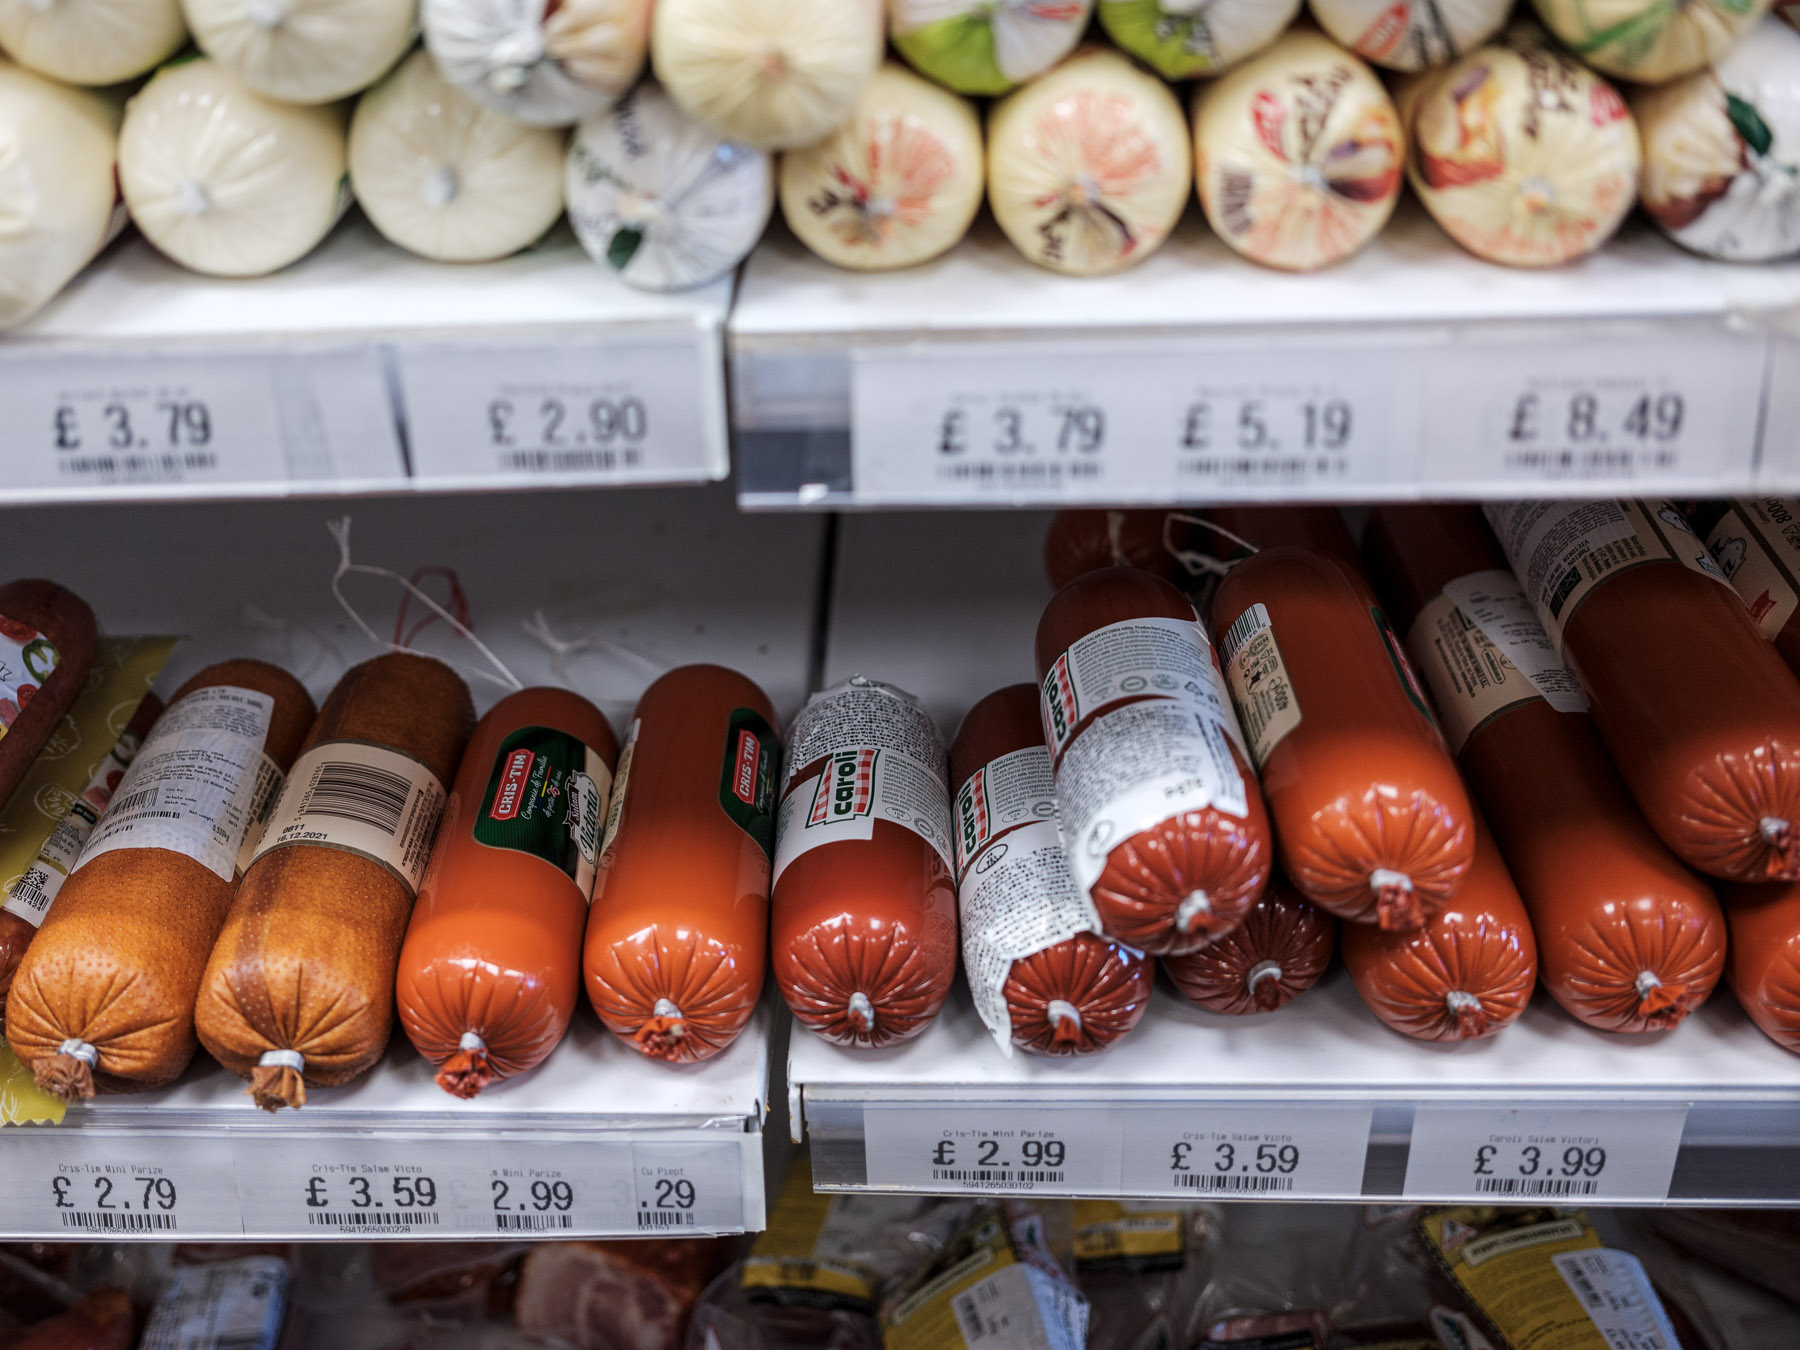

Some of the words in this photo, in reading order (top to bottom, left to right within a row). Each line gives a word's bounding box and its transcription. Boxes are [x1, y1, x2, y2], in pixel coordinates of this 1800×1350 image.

[54, 404, 82, 450] £
[104, 401, 212, 449] 3.79
[488, 400, 516, 445] £
[540, 397, 648, 444] 2.90
[939, 408, 966, 454] £
[993, 405, 1105, 453] 3.79
[1180, 401, 1210, 449] £
[1238, 399, 1353, 450] 5.19
[1509, 392, 1539, 440] £
[1567, 391, 1684, 441] 8.49
[1044, 669, 1066, 741] caroli
[834, 751, 858, 815] caroli
[571, 791, 580, 820] Salam
[959, 782, 977, 855] caroli
[580, 789, 598, 852] Victoria
[277, 831, 328, 843] 16.12.2021
[11, 893, 42, 912] 201424
[943, 1130, 988, 1138] Cris-Tim
[993, 1130, 1014, 1138] Mini
[1021, 1130, 1055, 1138] Parize
[1183, 1132, 1227, 1141] Cris-Tim
[1232, 1133, 1260, 1141] Salam
[1265, 1134, 1292, 1143] Victo
[1489, 1135, 1522, 1144] Caroli
[1528, 1135, 1556, 1144] Salam
[1561, 1136, 1600, 1145] Victori
[933, 1141, 955, 1165] £
[978, 1140, 1066, 1167] 2.99
[1171, 1142, 1192, 1170] £
[1214, 1143, 1299, 1173] 3.59
[1474, 1145, 1497, 1175] £
[1518, 1146, 1607, 1177] 3.99
[58, 1163, 101, 1174] Cris-Tim
[105, 1164, 126, 1173] Mini
[131, 1165, 163, 1174] Parize
[312, 1164, 356, 1173] Cris-Tim
[361, 1165, 389, 1173] Salam
[394, 1164, 422, 1173] Victo
[503, 1169, 524, 1177] Mini
[529, 1169, 562, 1178] Parize
[641, 1167, 653, 1176] Cu
[657, 1167, 684, 1177] Piept
[53, 1176, 74, 1207] £
[94, 1176, 177, 1209] 2.79
[305, 1176, 328, 1207] £
[349, 1176, 437, 1207] 3.59
[492, 1180, 573, 1210] 2.99
[641, 1179, 695, 1208] .29
[963, 1181, 1034, 1189] 5941265030102
[340, 1225, 411, 1233] 5941265000228
